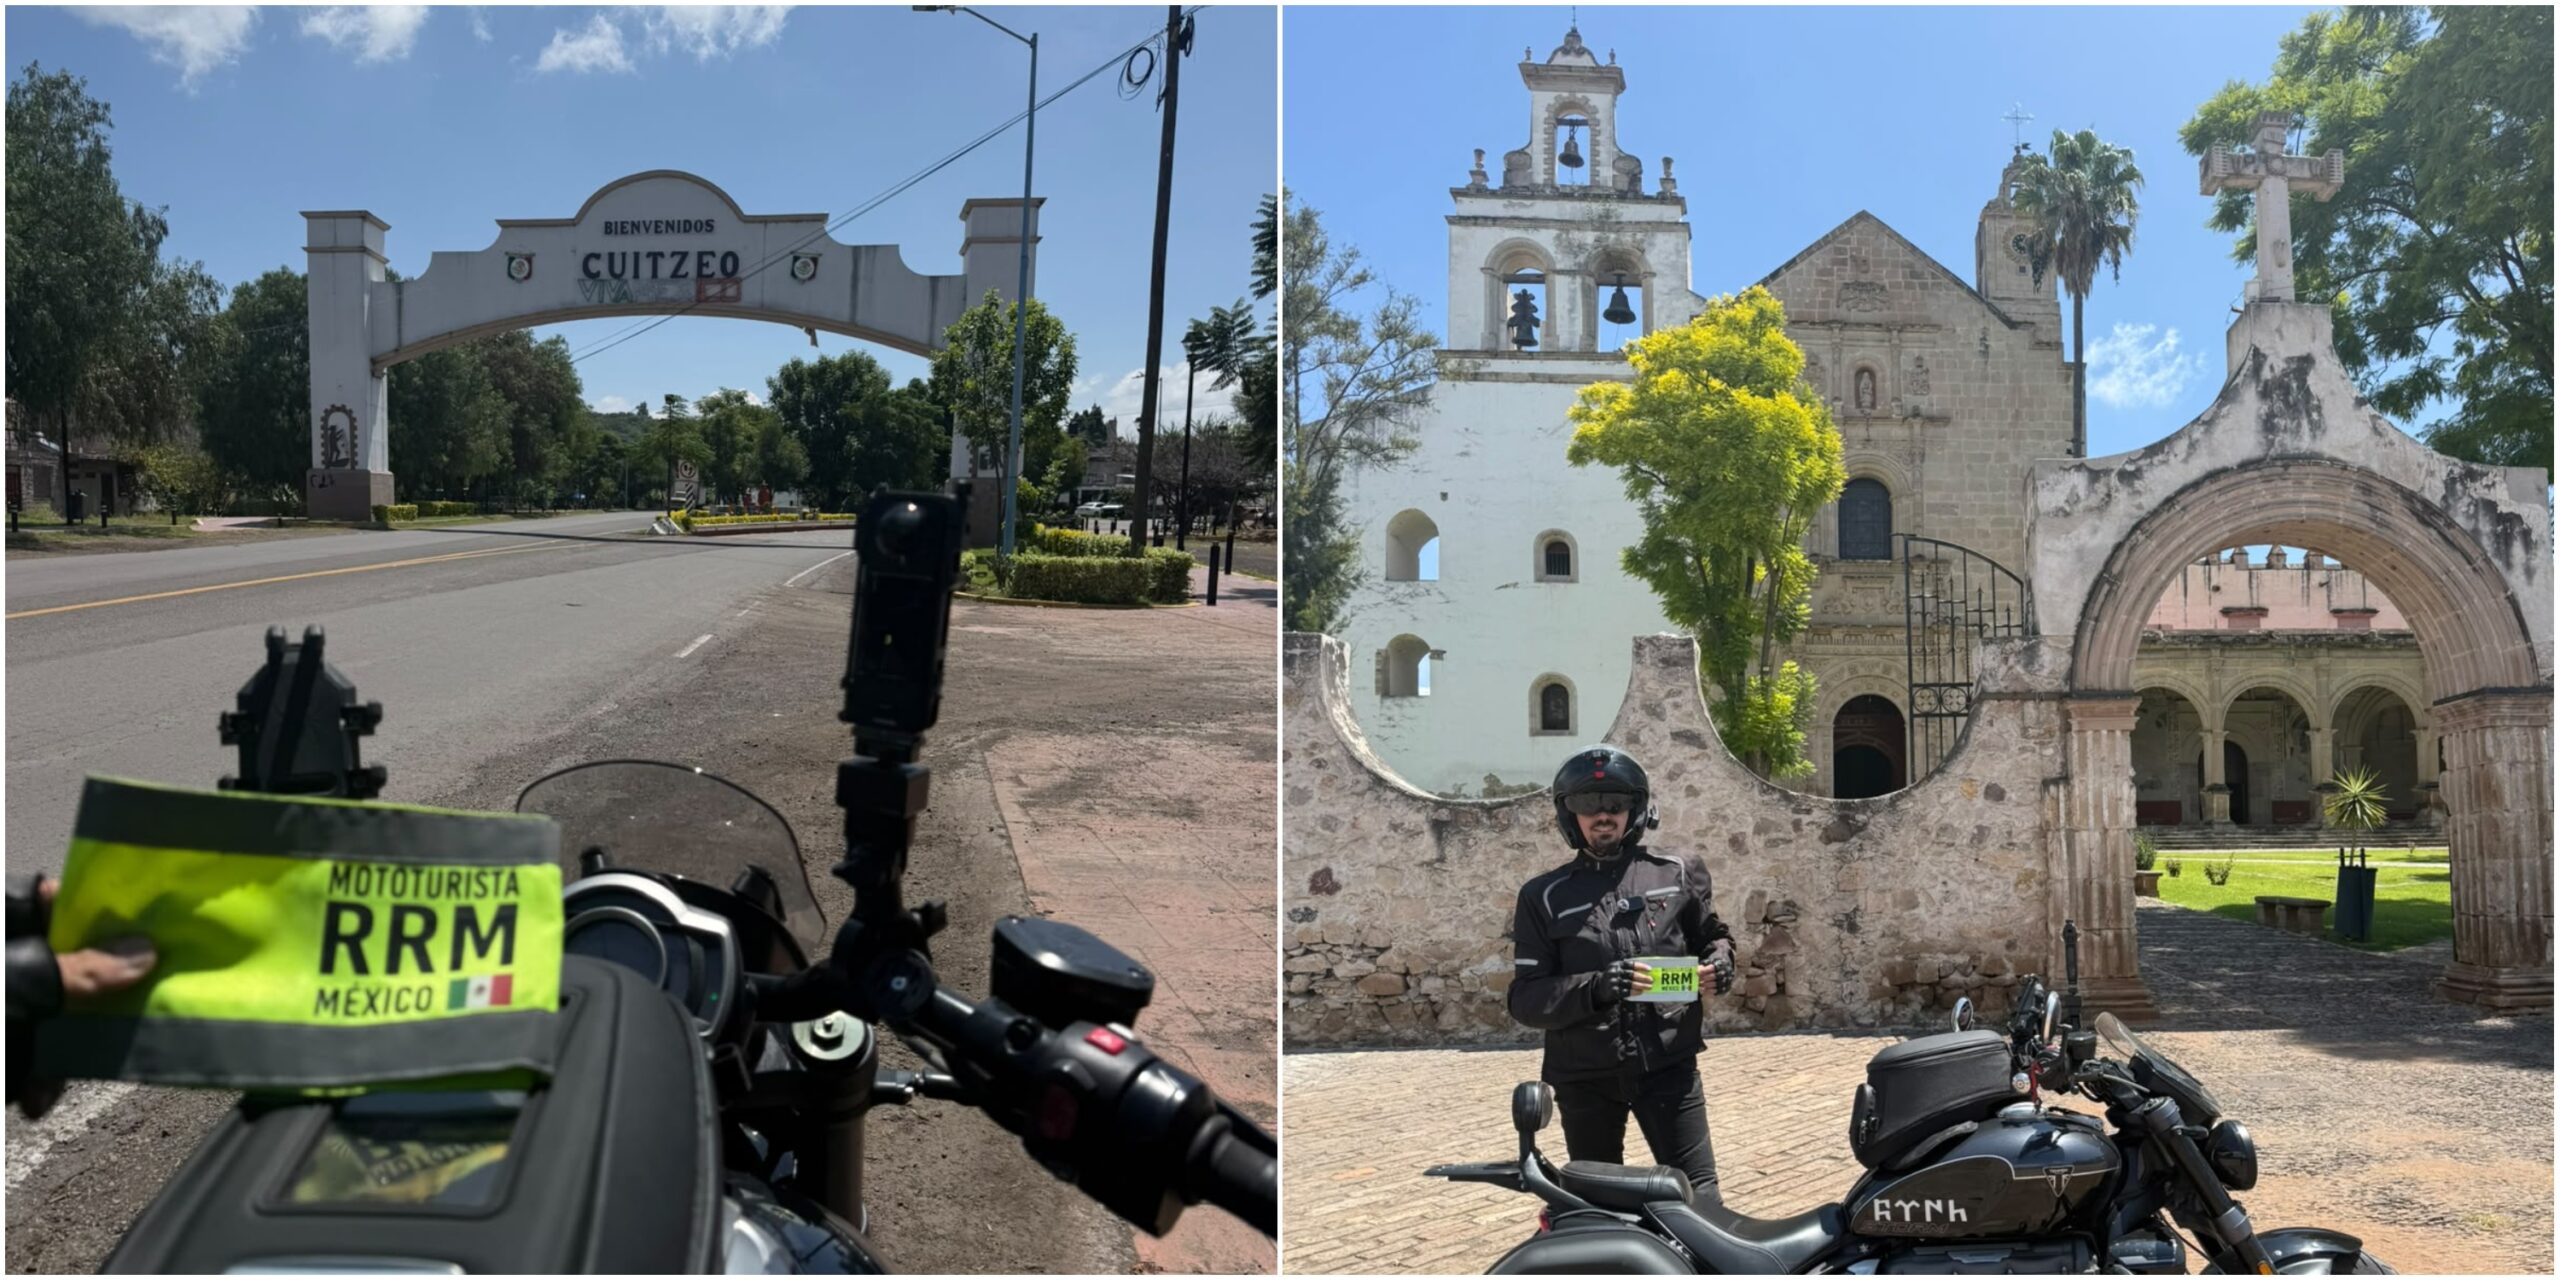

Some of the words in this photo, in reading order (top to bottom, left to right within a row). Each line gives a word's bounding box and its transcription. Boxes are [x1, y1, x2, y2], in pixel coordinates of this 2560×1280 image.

[604, 219, 714, 235] BIENVENIDOS
[582, 250, 740, 279] CUITZEO
[330, 865, 519, 898] MOTOTURISTA
[319, 902, 518, 975] RRM
[1661, 973, 1692, 985] RRM
[314, 983, 433, 1016] MÉXICO
